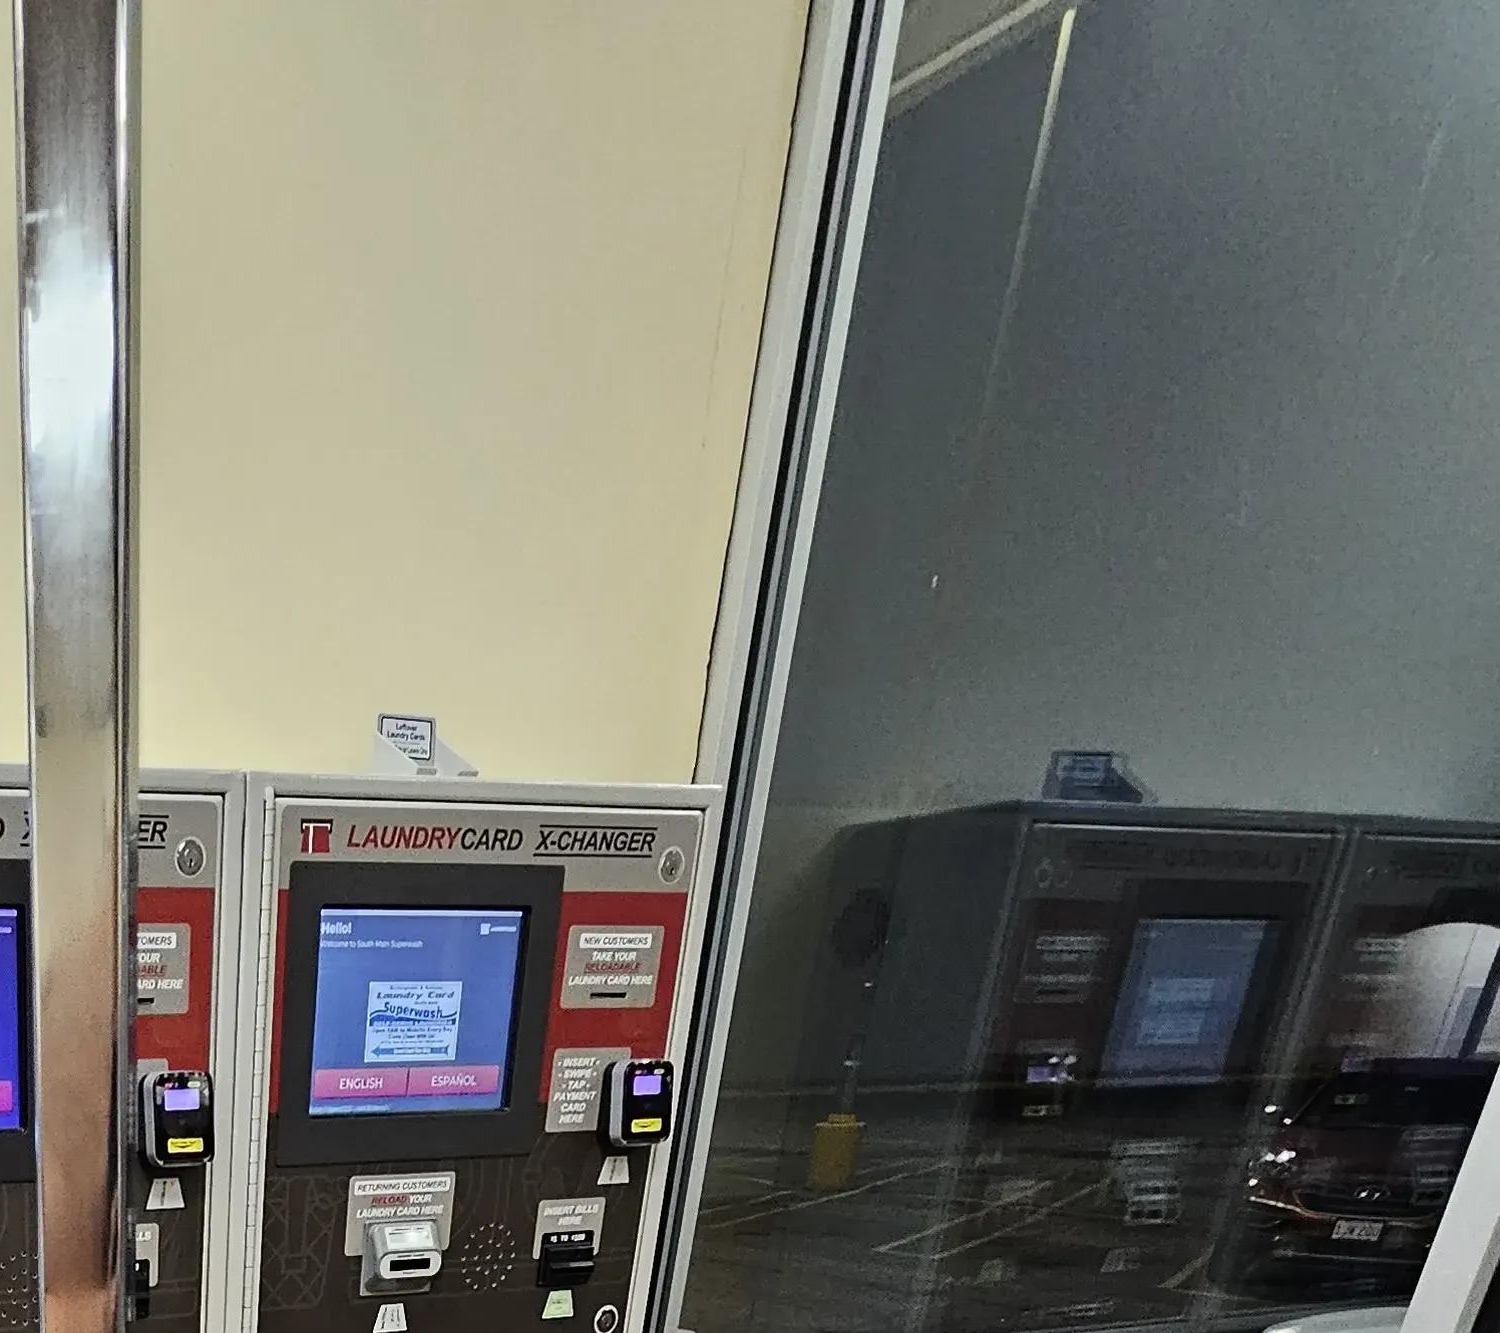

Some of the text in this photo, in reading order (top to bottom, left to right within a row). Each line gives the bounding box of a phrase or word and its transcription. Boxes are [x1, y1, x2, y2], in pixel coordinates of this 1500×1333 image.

[536, 828, 656, 852] X-CHANGER
[320, 921, 352, 935] Hello!
[583, 936, 649, 946] NEW CUSTOMERS
[591, 951, 637, 962] TAKE YOUR
[156, 978, 184, 990] HERE
[568, 975, 654, 987] LAUNDRY CARD HERE
[376, 991, 455, 1000] Laundry Card
[383, 1001, 443, 1019] Superwash
[562, 1057, 596, 1068] INSERT
[563, 1068, 592, 1079] SWIPE
[338, 1073, 477, 1090] ENGLISH ESPAÑOL
[567, 1080, 586, 1090] TAP
[553, 1091, 597, 1102] PAYMENT
[560, 1102, 587, 1114] CARD
[558, 1113, 585, 1124] HERE
[357, 1180, 447, 1192] RETURNING CUSTOMERS
[371, 1194, 433, 1204] RELOAD YOUR
[356, 1205, 444, 1218] LAUNDRY CARD HERE
[543, 1204, 599, 1216] INSERT BILLS
[557, 1215, 583, 1226] HERE
